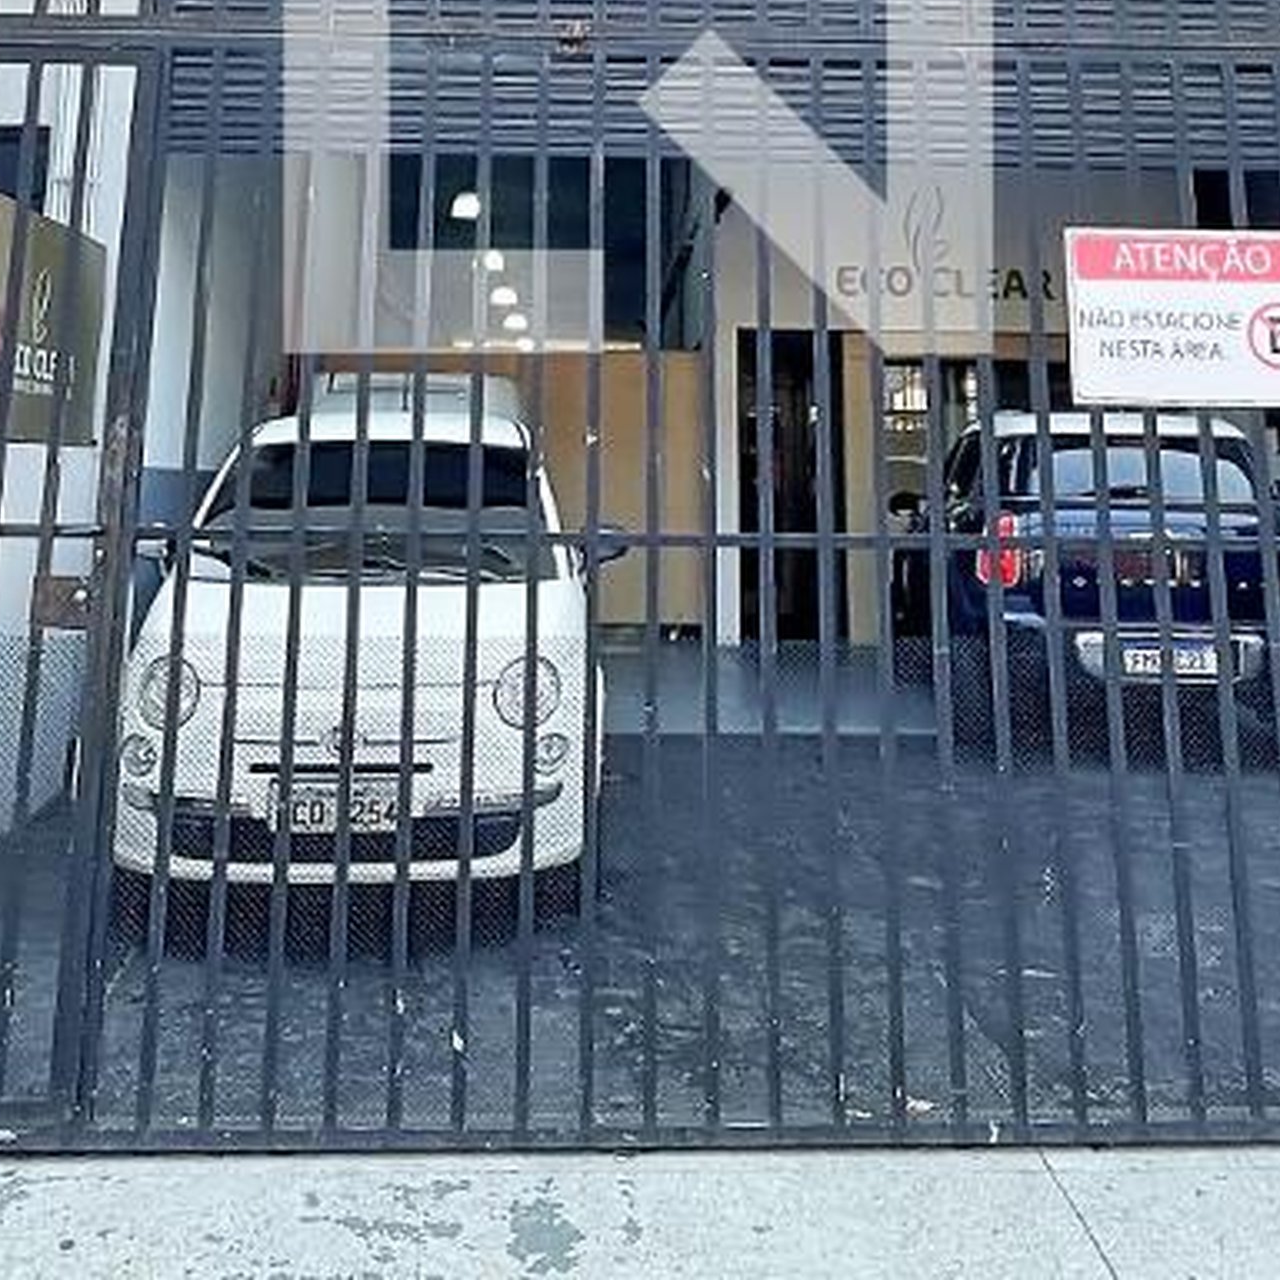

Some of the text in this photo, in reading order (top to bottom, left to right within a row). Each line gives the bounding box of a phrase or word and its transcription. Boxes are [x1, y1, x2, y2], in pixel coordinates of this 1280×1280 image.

[1114, 237, 1271, 282] ATENÇÃO
[1079, 304, 1243, 332] NÃO ESTACIONE
[1099, 338, 1166, 361] NESTA
